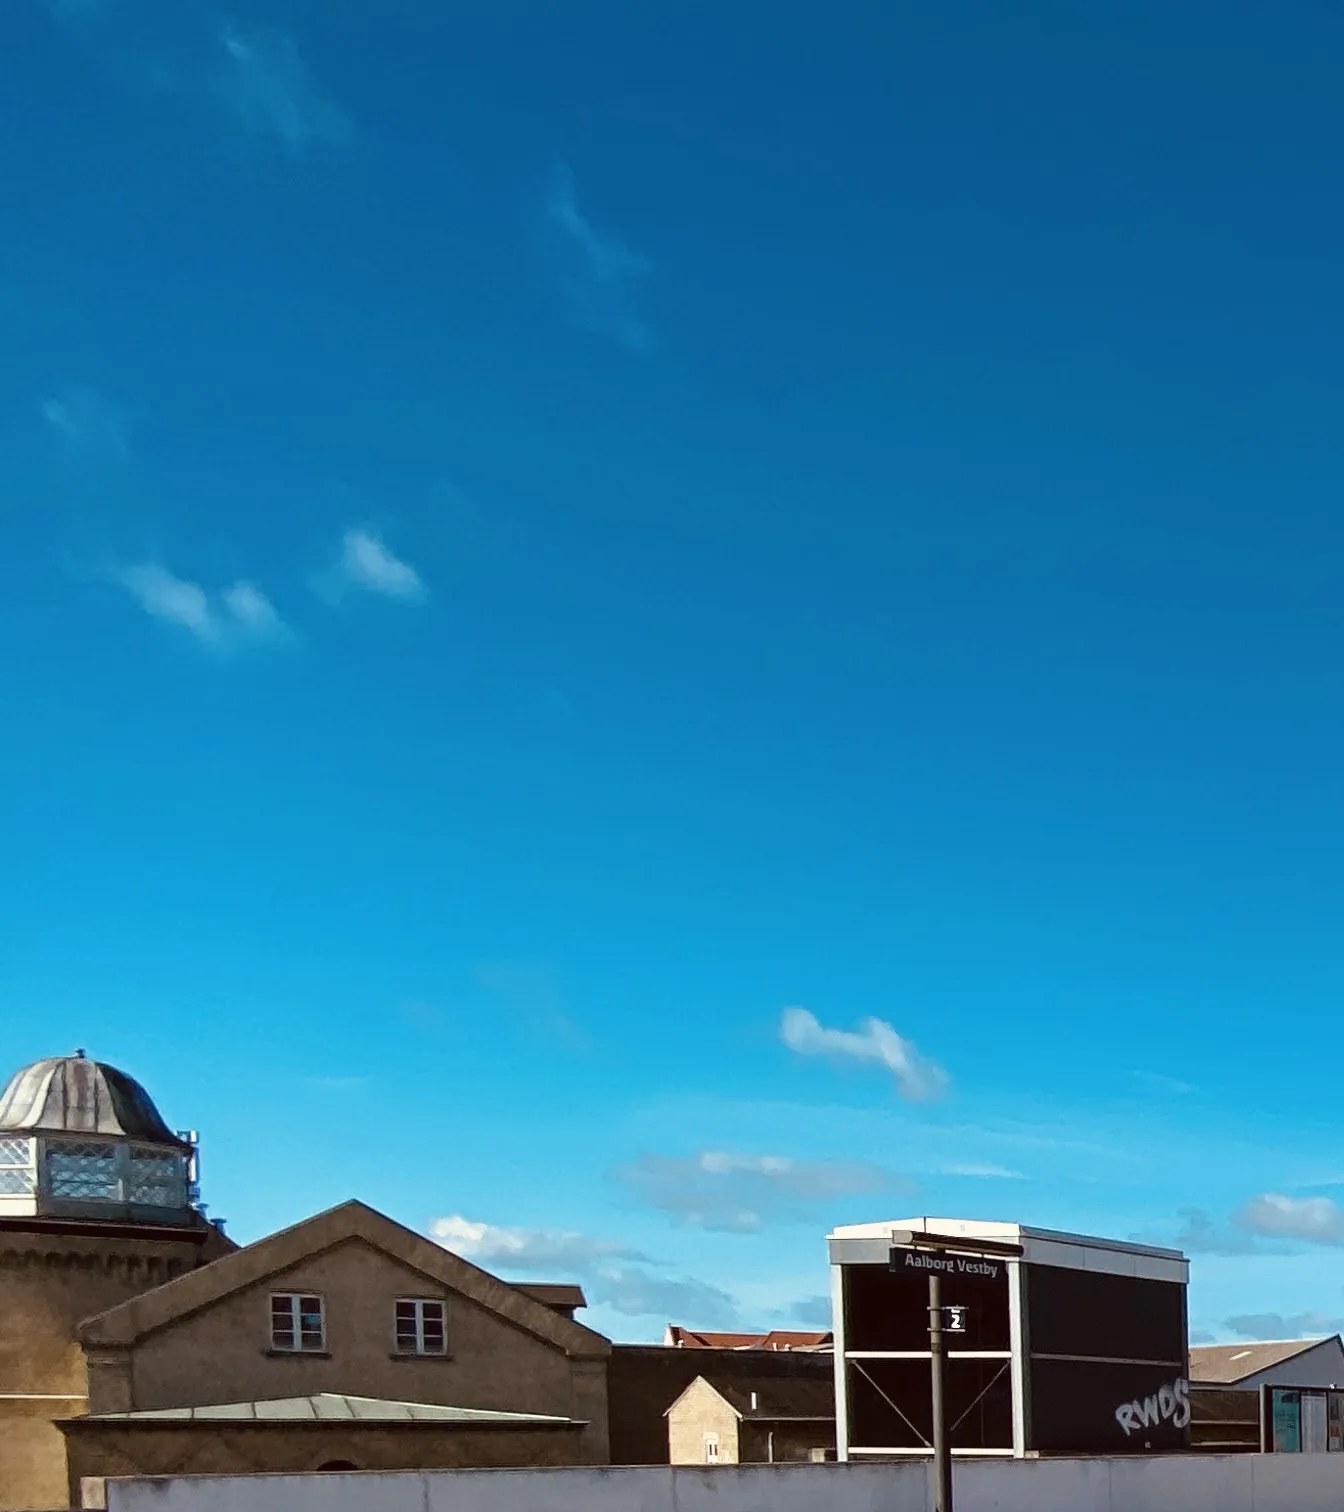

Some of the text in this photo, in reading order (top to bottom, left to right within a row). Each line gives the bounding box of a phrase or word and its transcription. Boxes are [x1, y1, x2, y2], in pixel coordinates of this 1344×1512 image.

[905, 1253, 998, 1278] Aalborg Vestby
[951, 1314, 961, 1329] 2
